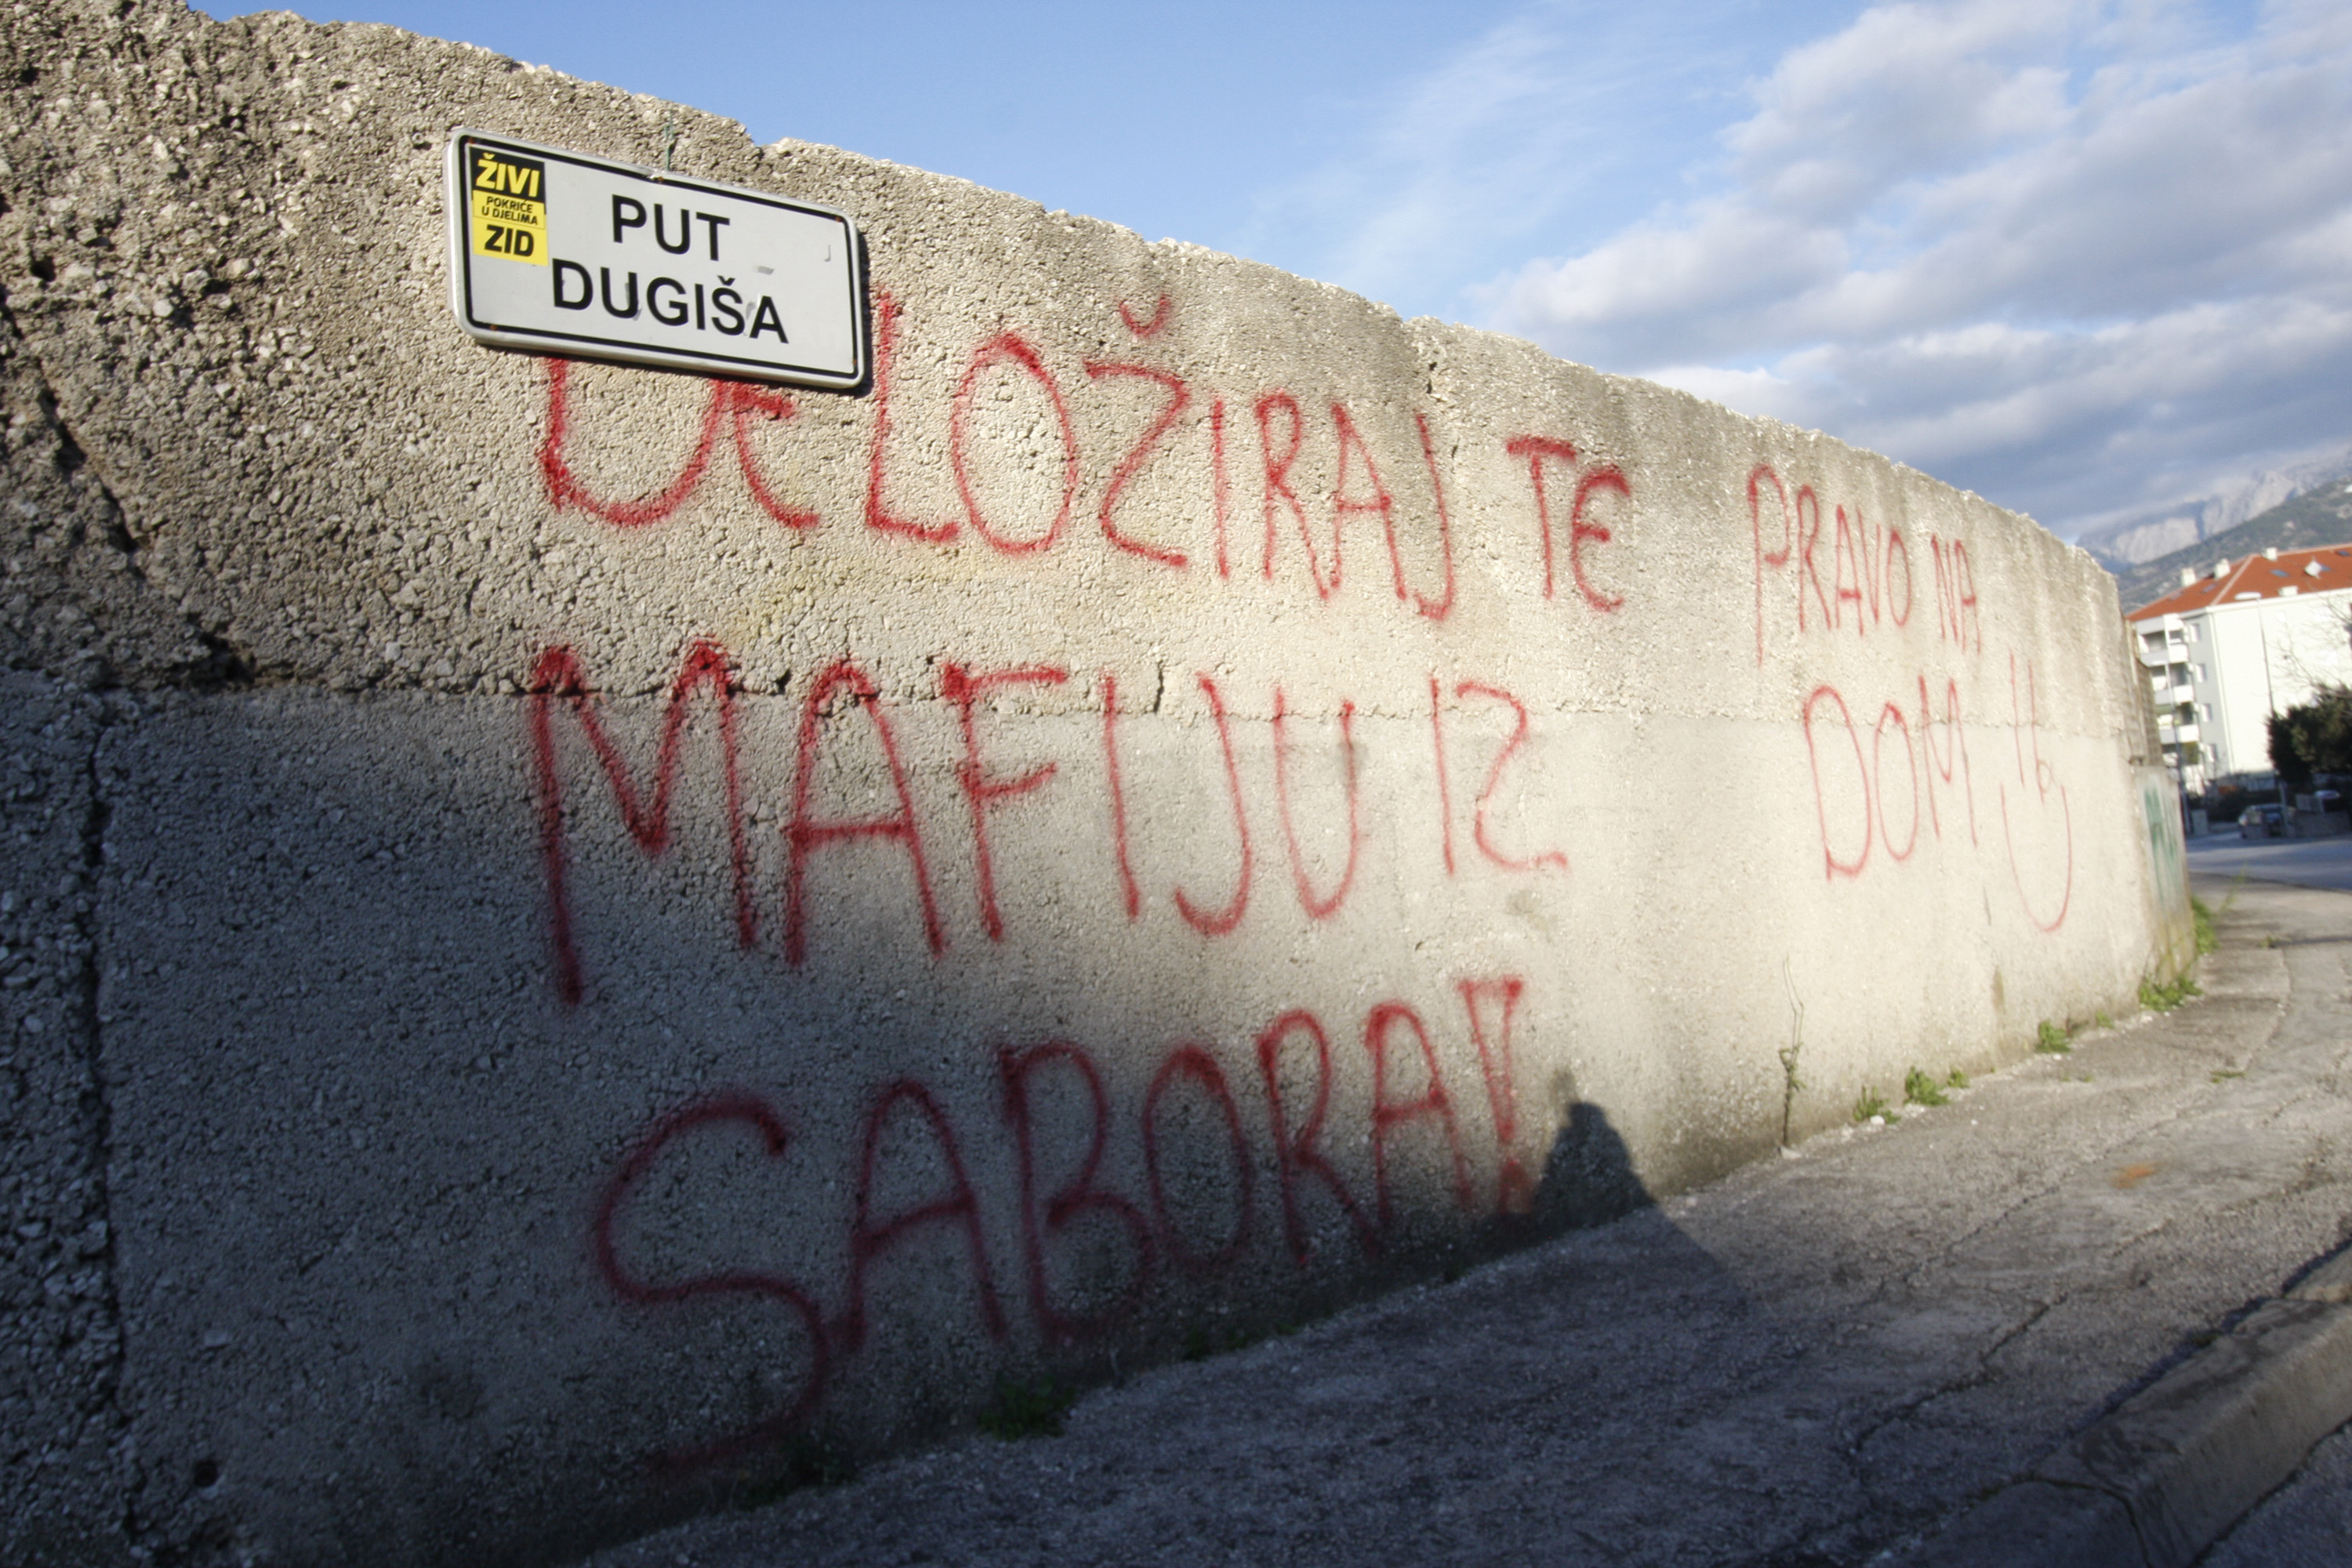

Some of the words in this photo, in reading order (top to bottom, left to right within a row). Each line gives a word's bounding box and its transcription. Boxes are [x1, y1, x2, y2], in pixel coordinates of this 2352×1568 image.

[475, 152, 540, 198] ŽIVI
[481, 206, 490, 216] U
[492, 209, 539, 226] DJELIMA
[486, 196, 533, 213] POKRIĆE
[612, 194, 730, 261] PUT
[484, 223, 535, 257] ZID
[552, 258, 789, 344] DUGIŠA
[1747, 463, 1911, 669] PRAVO
[1930, 532, 1982, 654] NA
[1428, 673, 1568, 876] IZ
